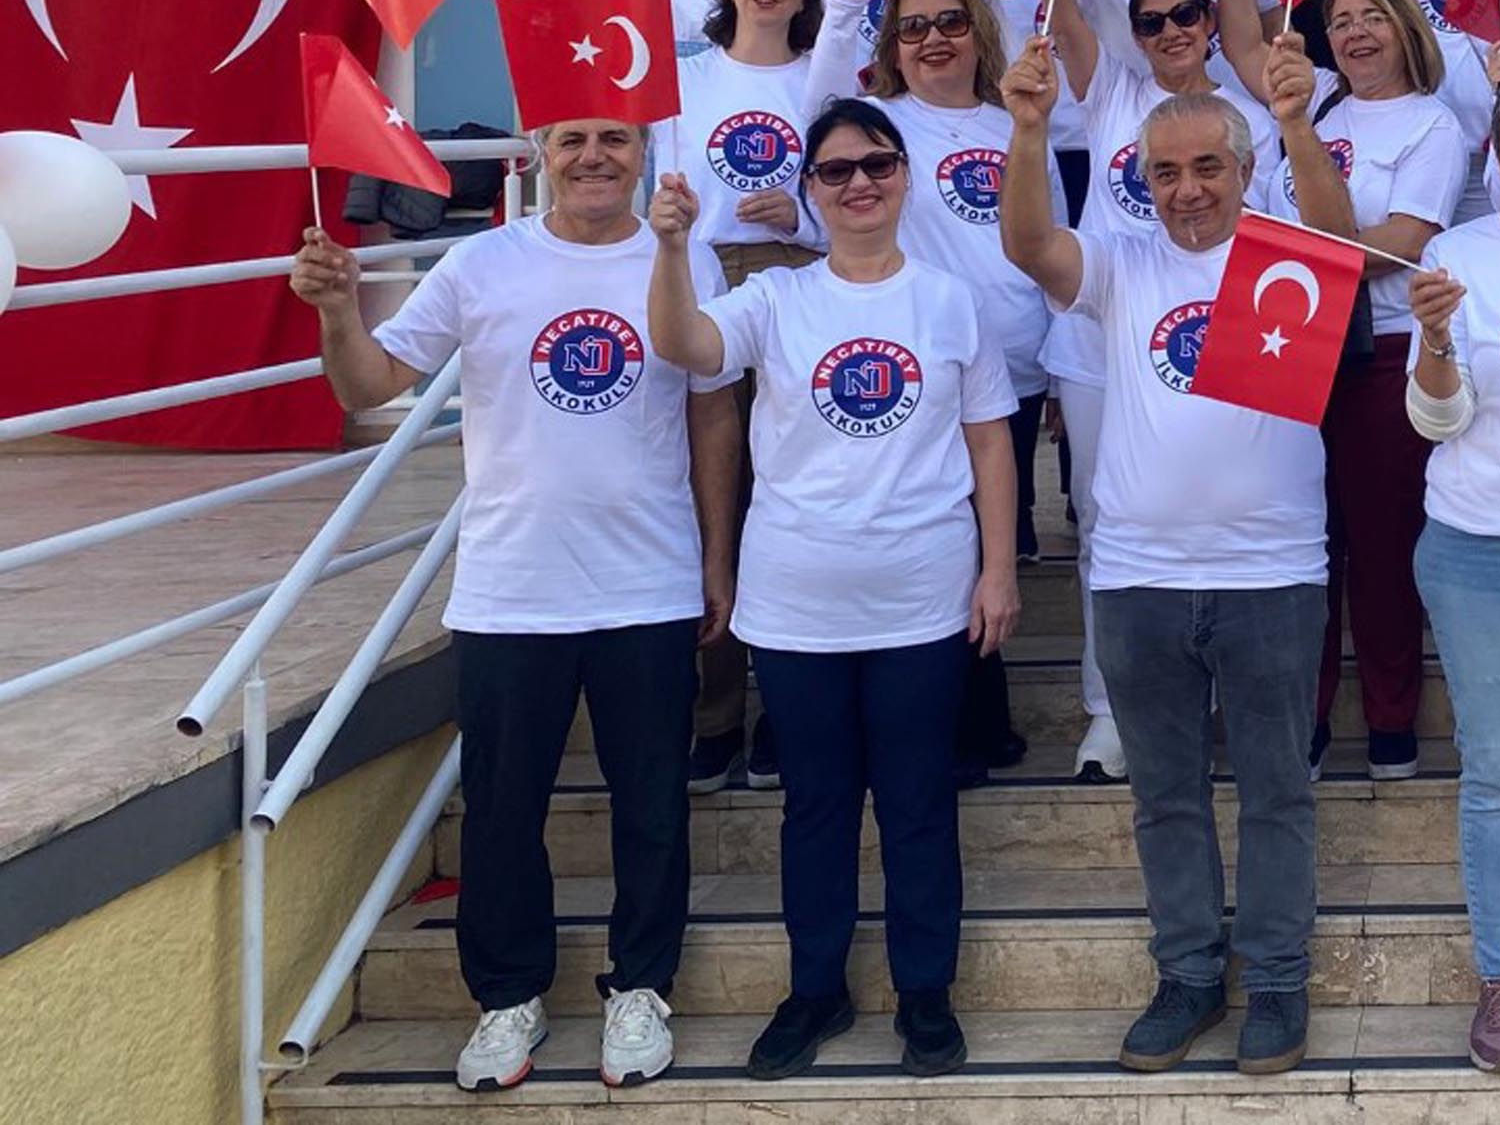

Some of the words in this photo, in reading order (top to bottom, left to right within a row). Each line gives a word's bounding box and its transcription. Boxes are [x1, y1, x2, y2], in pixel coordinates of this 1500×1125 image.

[538, 314, 639, 354] NECATİBEY
[1156, 306, 1210, 343] NECAT
[818, 341, 916, 379] NECATİBEY
[538, 375, 633, 411] İLKOKULU
[821, 397, 913, 434] İLKOKULU
